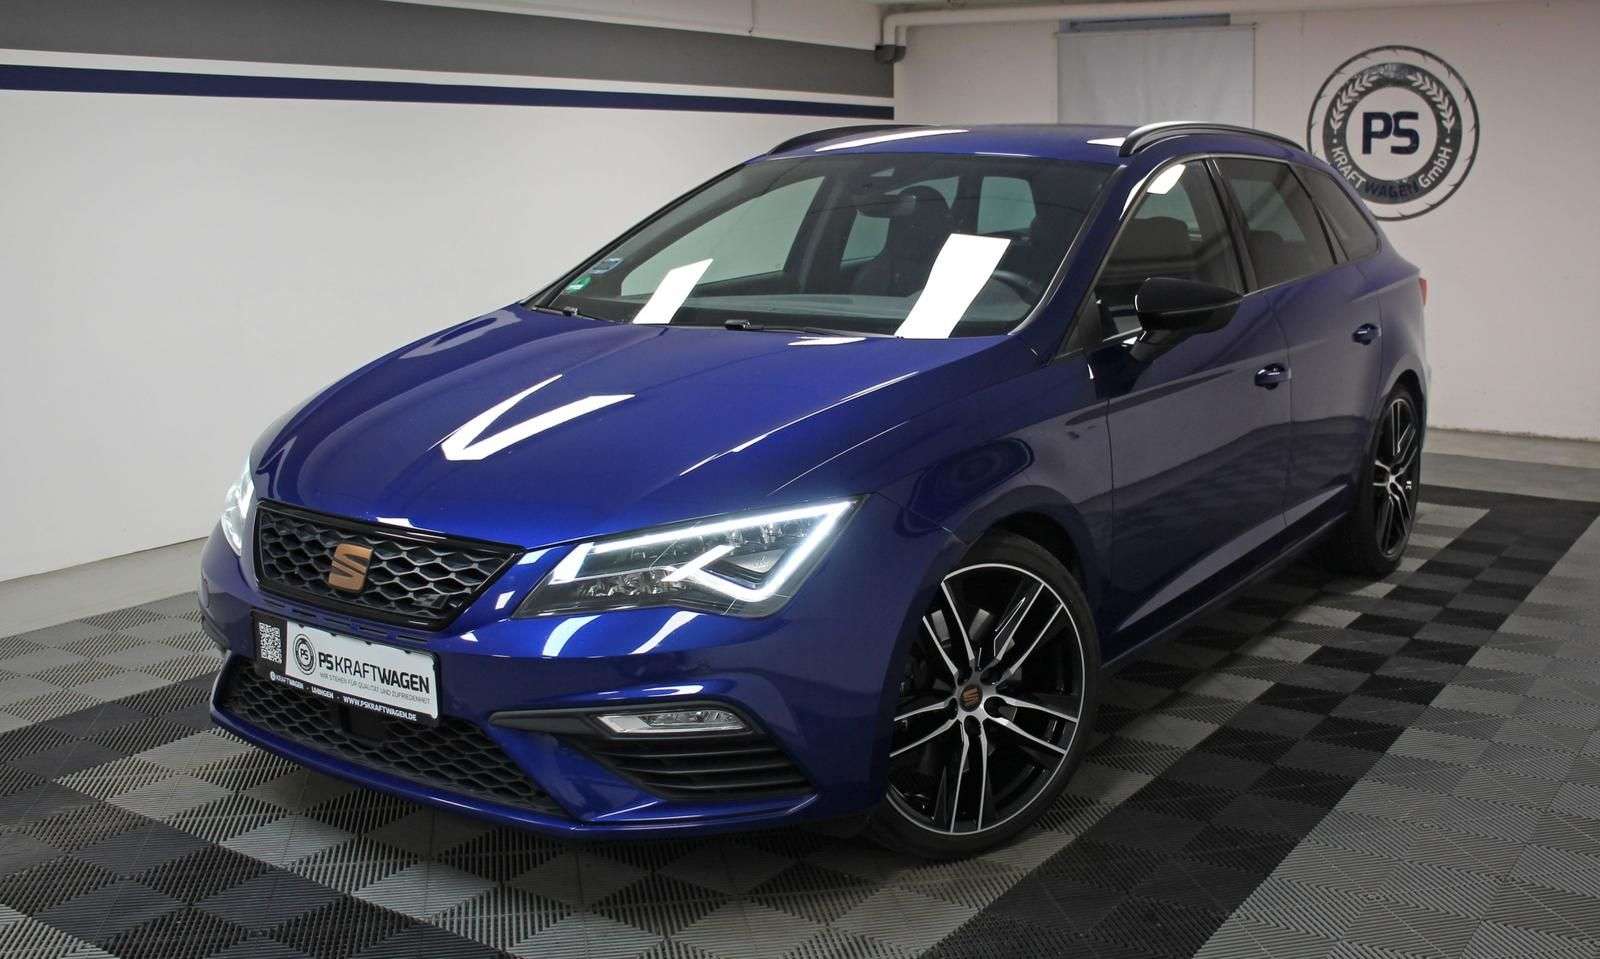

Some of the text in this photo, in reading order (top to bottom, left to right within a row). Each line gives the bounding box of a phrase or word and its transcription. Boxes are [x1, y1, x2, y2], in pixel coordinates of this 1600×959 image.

[1362, 111, 1420, 155] PS
[1331, 146, 1367, 189] KRAFT
[1418, 147, 1453, 189] GmbH
